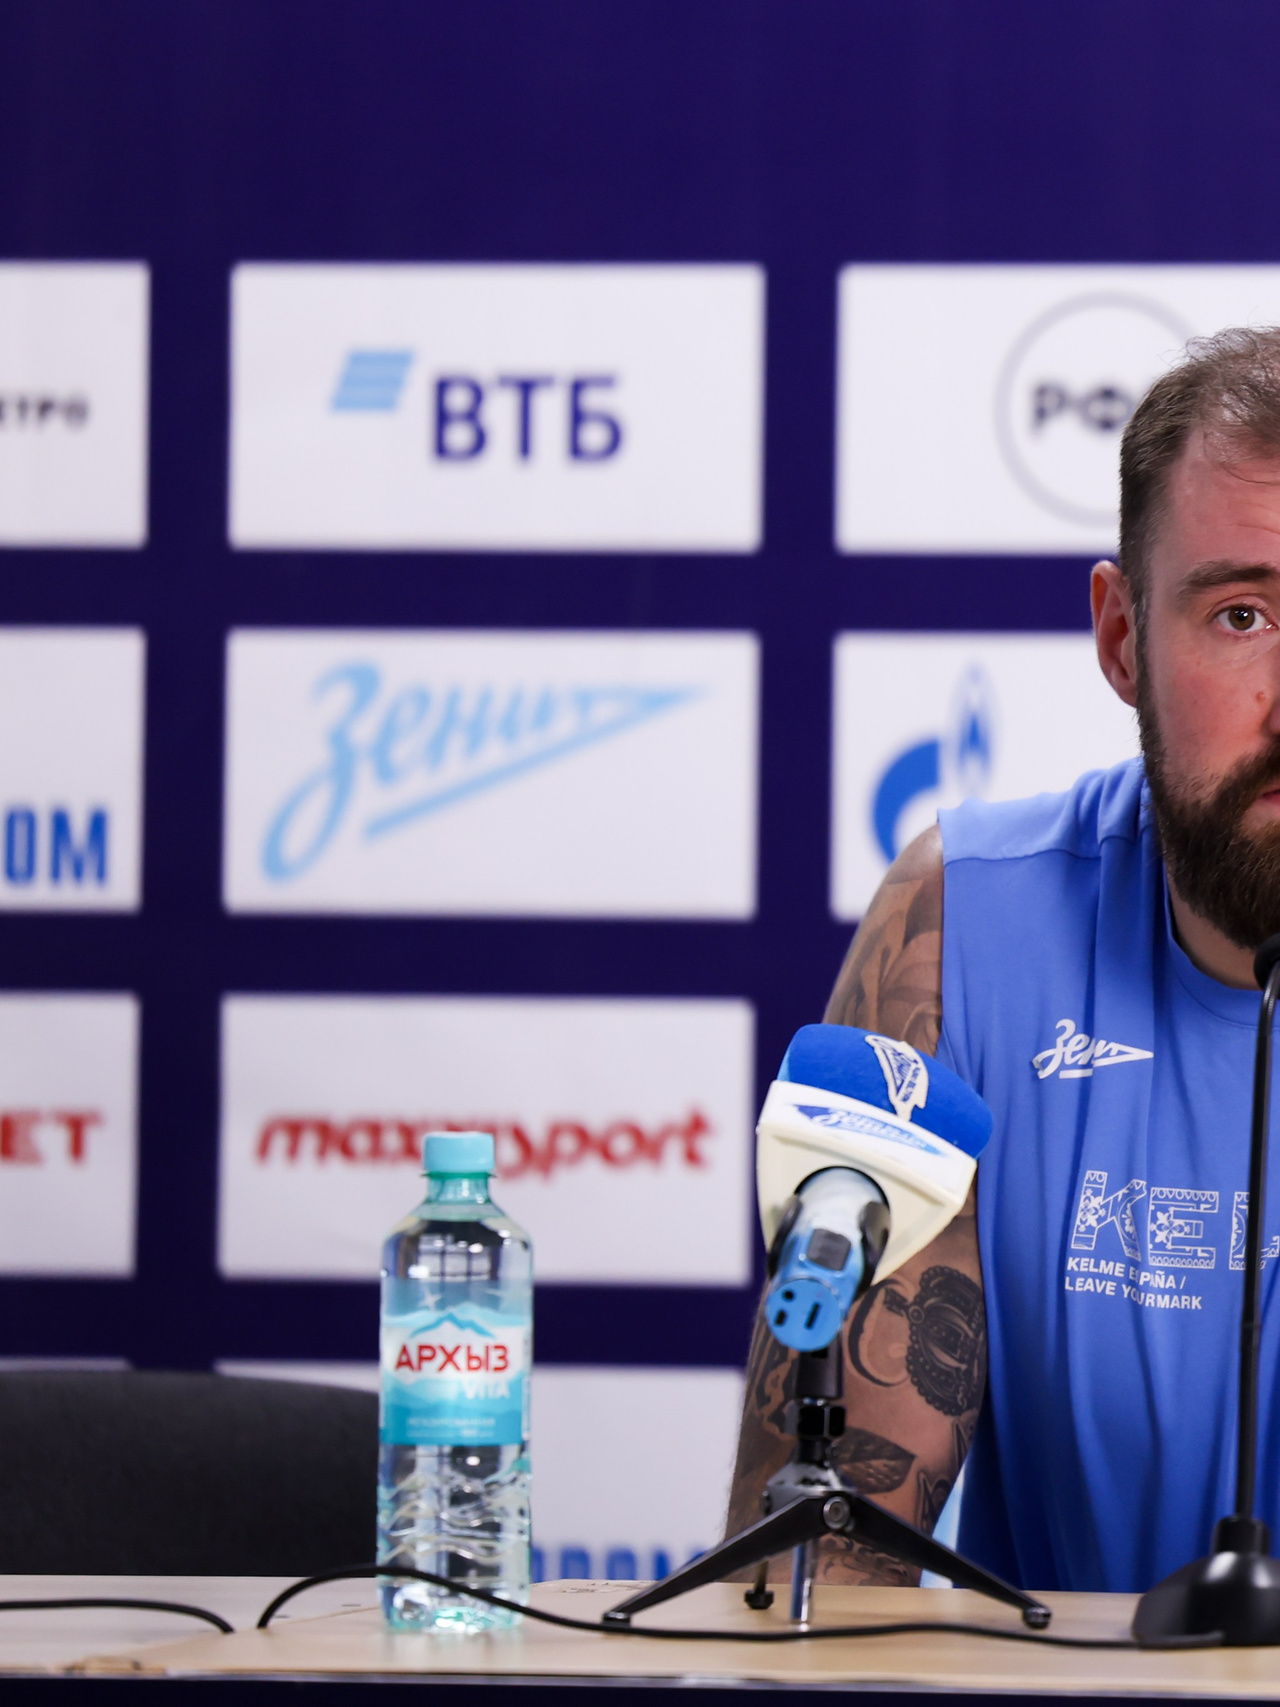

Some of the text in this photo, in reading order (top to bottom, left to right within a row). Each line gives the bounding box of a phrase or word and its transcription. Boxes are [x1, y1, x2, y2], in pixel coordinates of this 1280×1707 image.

[430, 374, 624, 464] ВТБ
[256, 1104, 712, 1179] maxsport
[1066, 1257, 1126, 1278] KELME
[1064, 1276, 1118, 1296] LEAVE
[394, 1343, 509, 1373] АРХЫЗ
